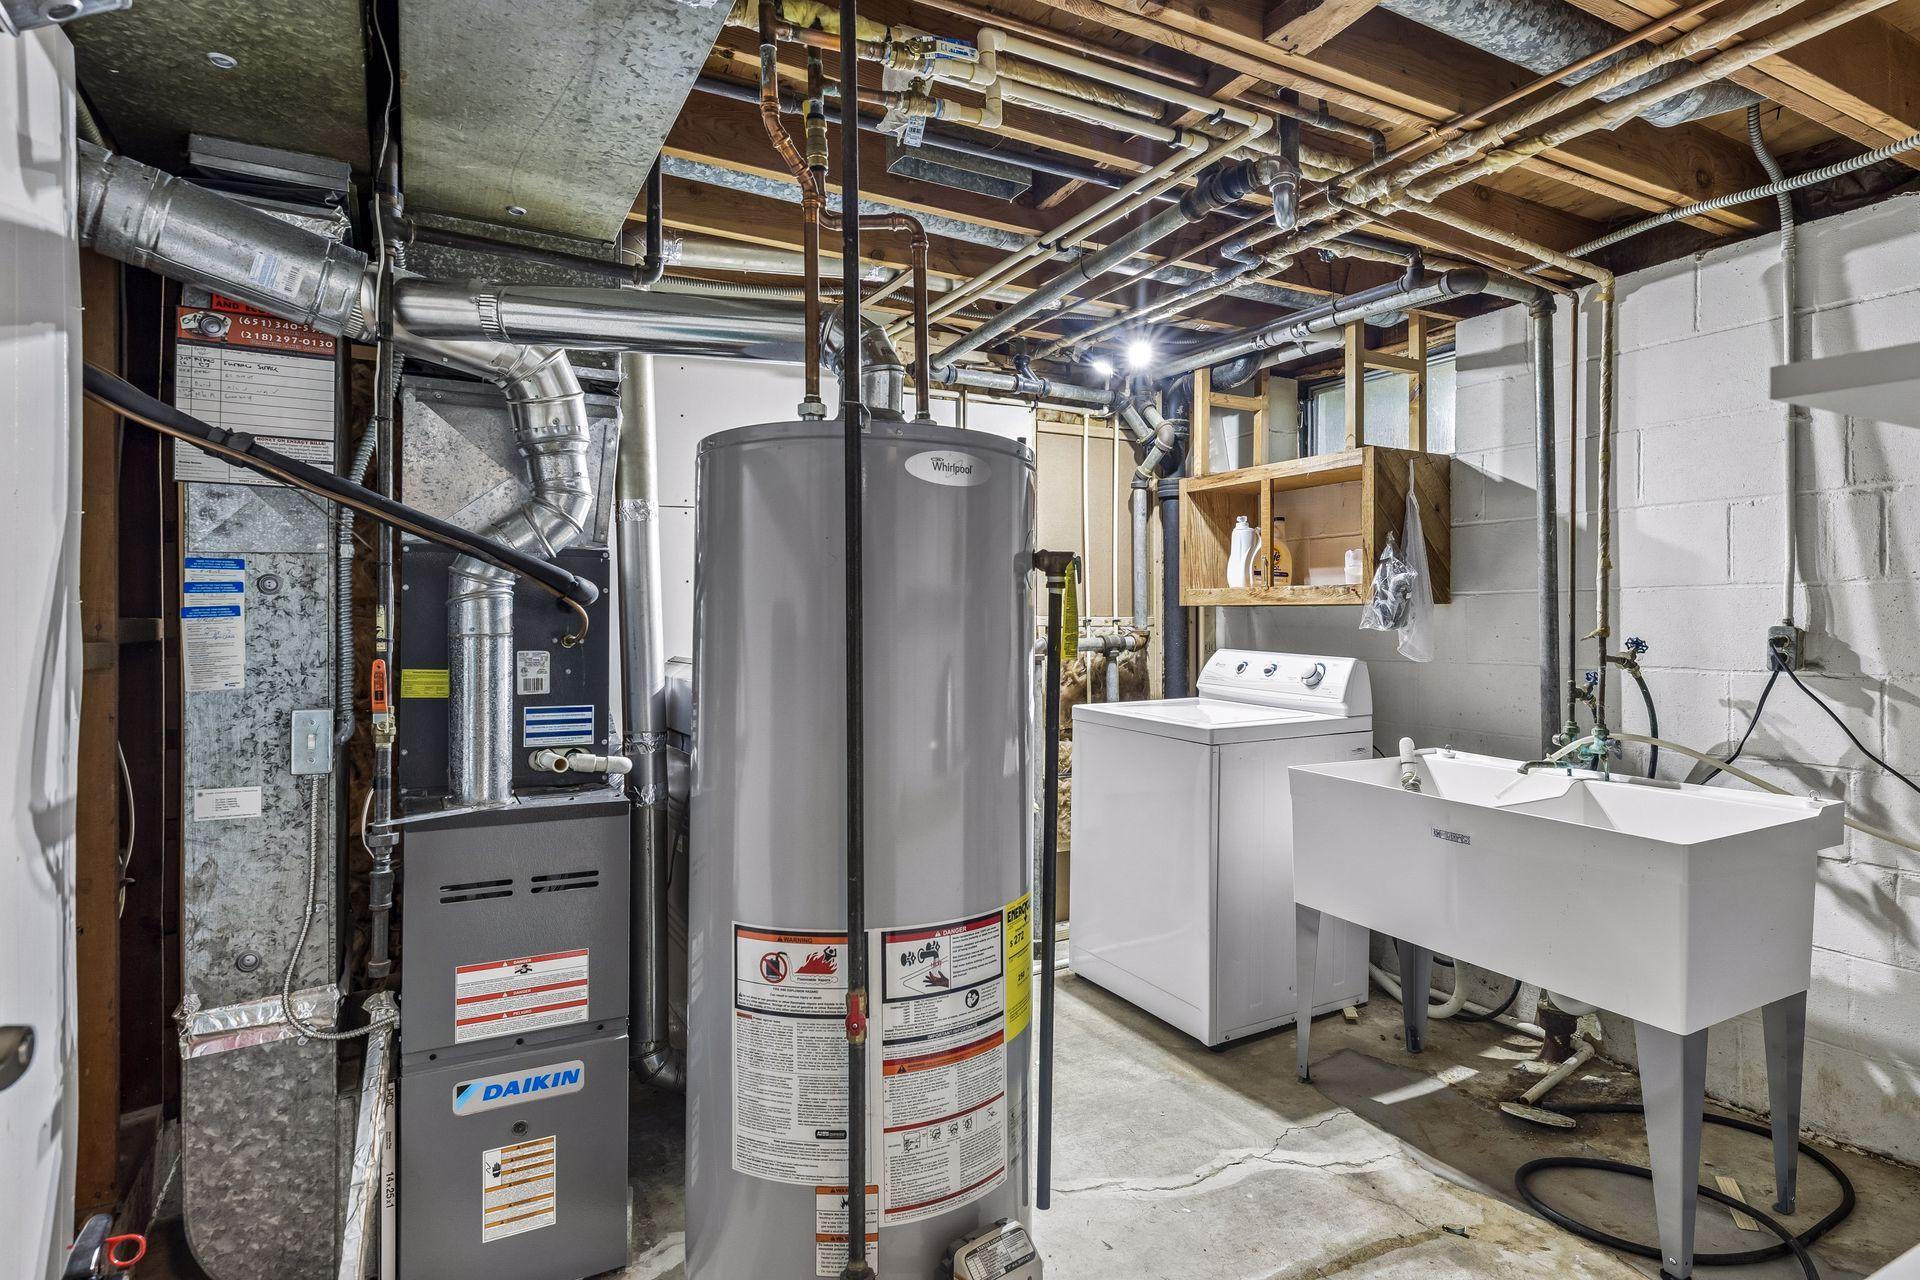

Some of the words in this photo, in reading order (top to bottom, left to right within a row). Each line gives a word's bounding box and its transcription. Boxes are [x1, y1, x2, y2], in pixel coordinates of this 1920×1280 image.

[239, 316, 271, 328] (651)
[241, 330, 273, 341] (218)
[276, 334, 333, 348] 297-0130
[932, 461, 972, 476] Whirlpool
[943, 926, 967, 936] DANGER
[482, 1068, 580, 1101] DAIKIN
